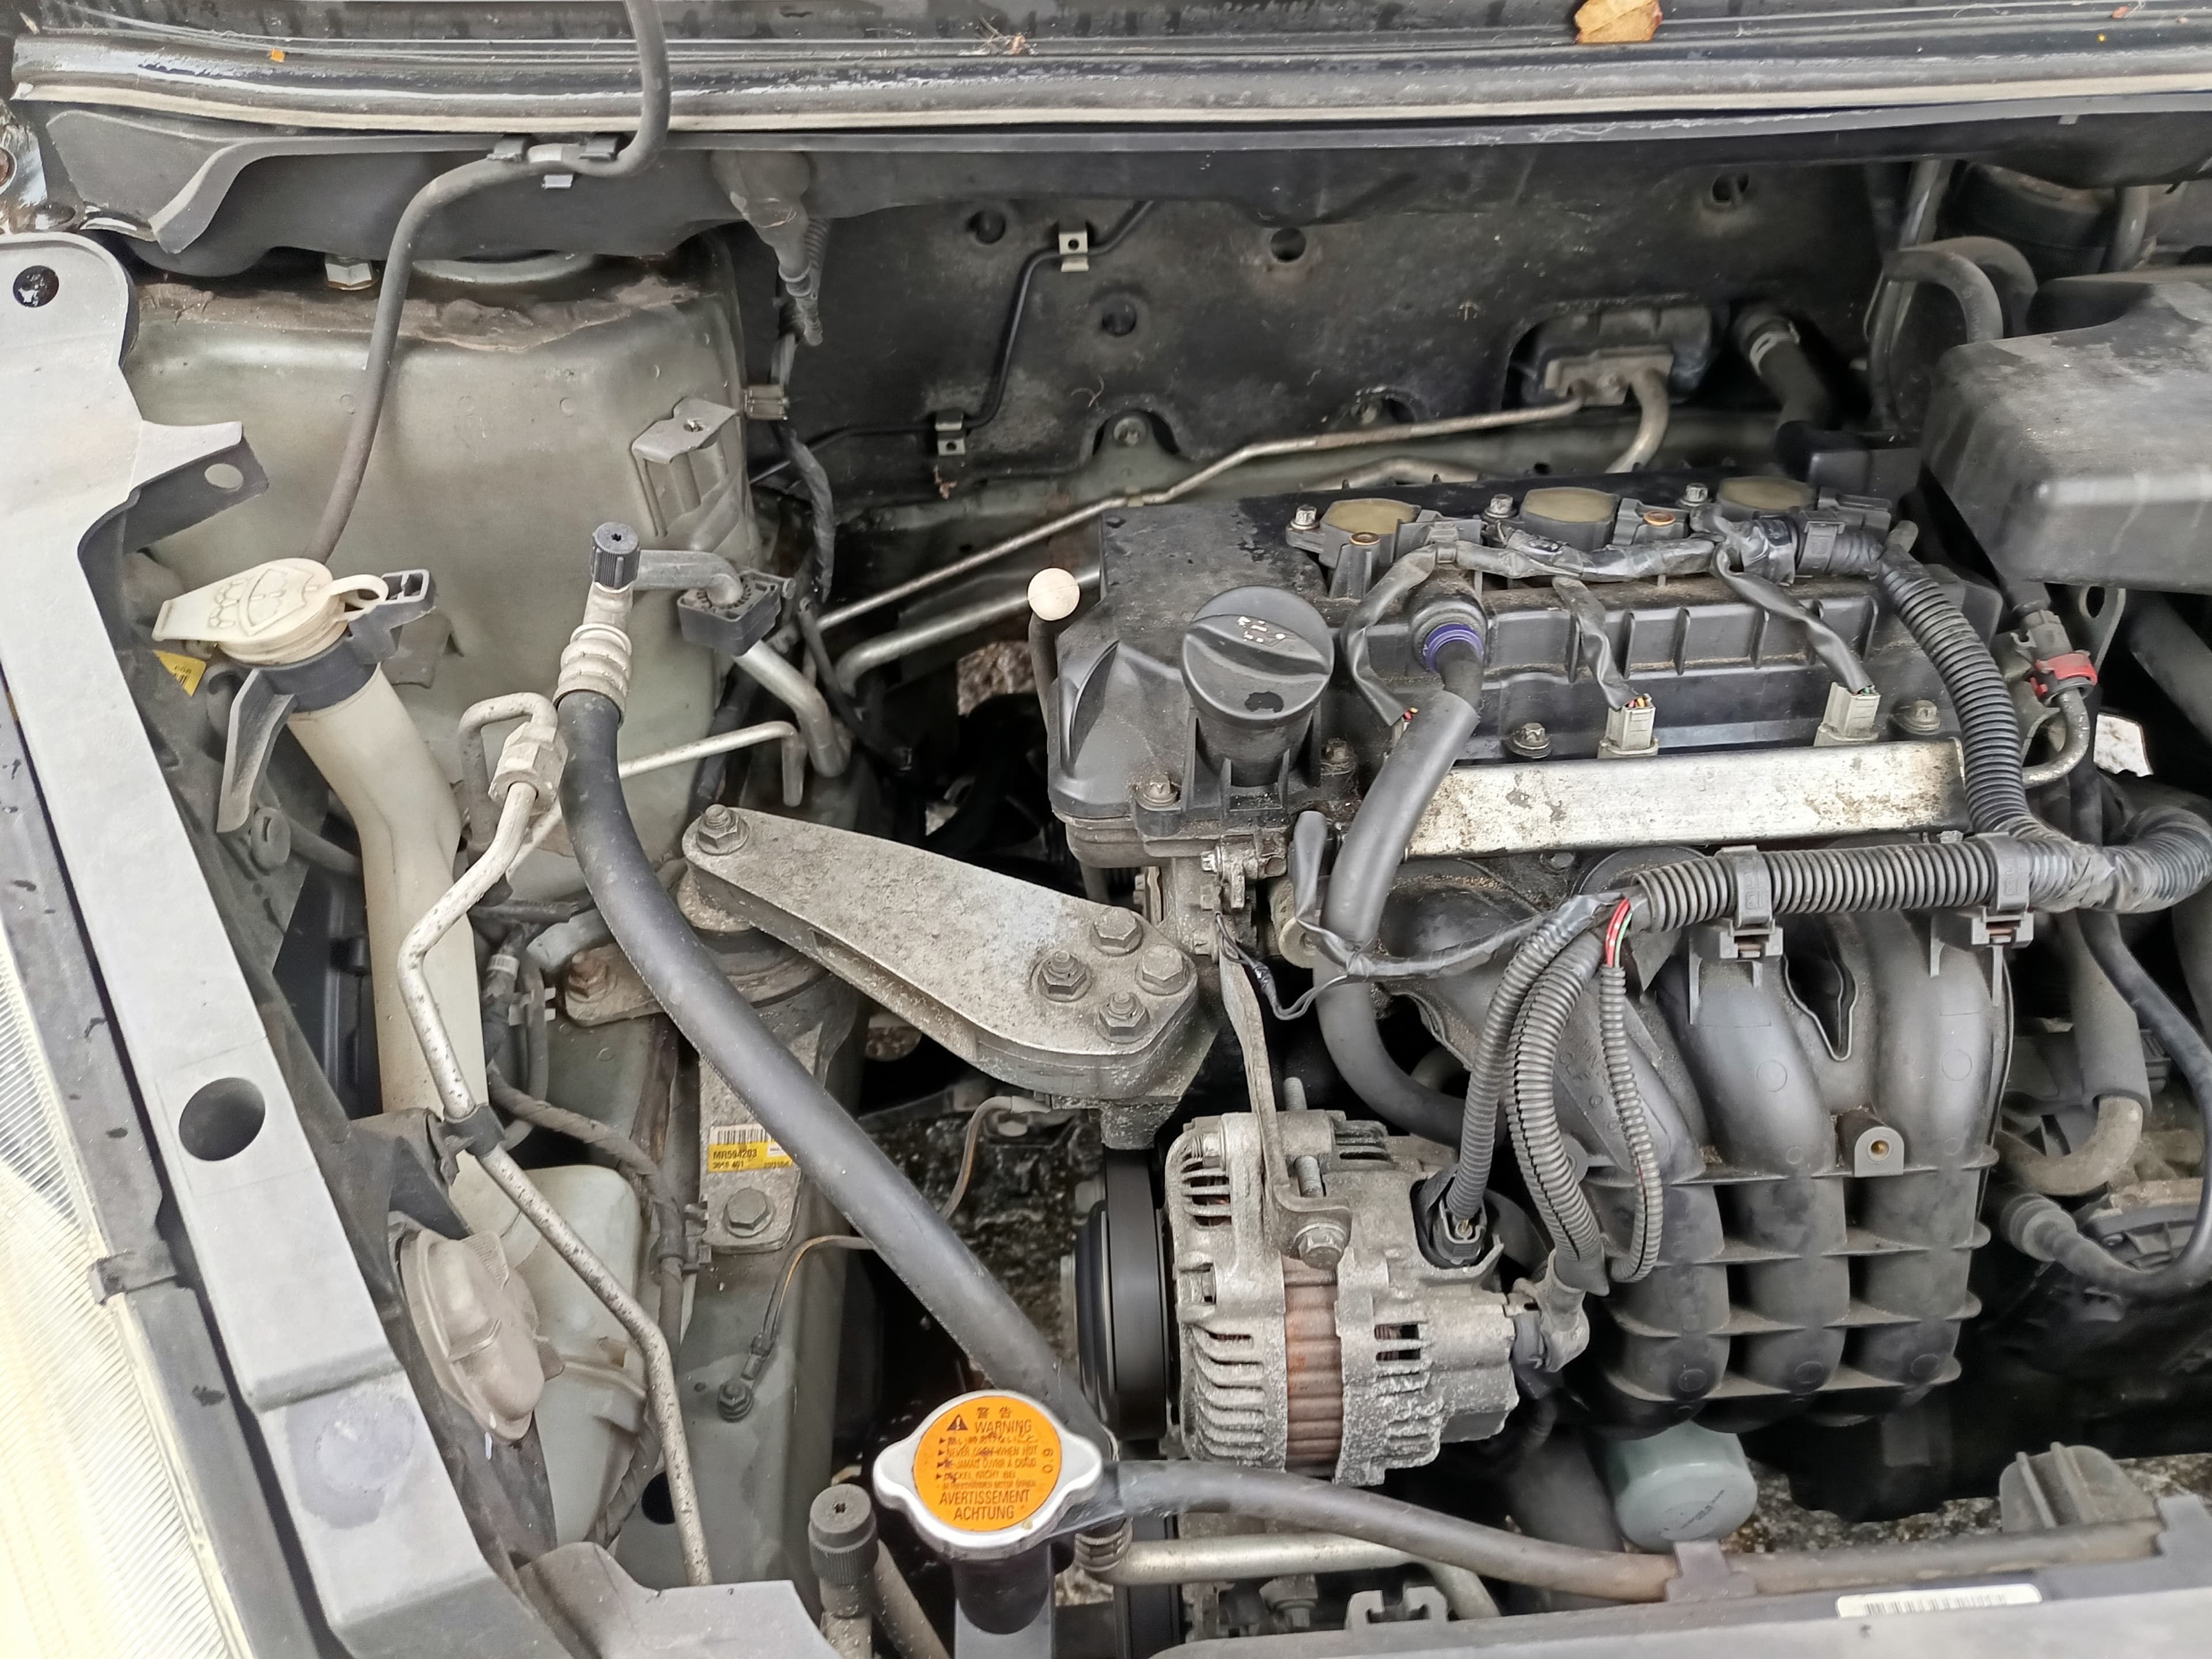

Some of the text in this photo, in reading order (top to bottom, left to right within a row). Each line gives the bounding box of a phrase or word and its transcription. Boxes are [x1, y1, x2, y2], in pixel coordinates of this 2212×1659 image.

[975, 1419, 1032, 1434] WARNING
[947, 1445, 970, 1457] NEVER
[996, 1445, 1019, 1456] WHEN
[1022, 1444, 1039, 1456] HOT
[975, 1469, 999, 1479] NICHT
[1003, 1469, 1016, 1479] BEI
[940, 1489, 1031, 1505] AVERTISSEMENT
[953, 1506, 1016, 1521] ACHTUNG
